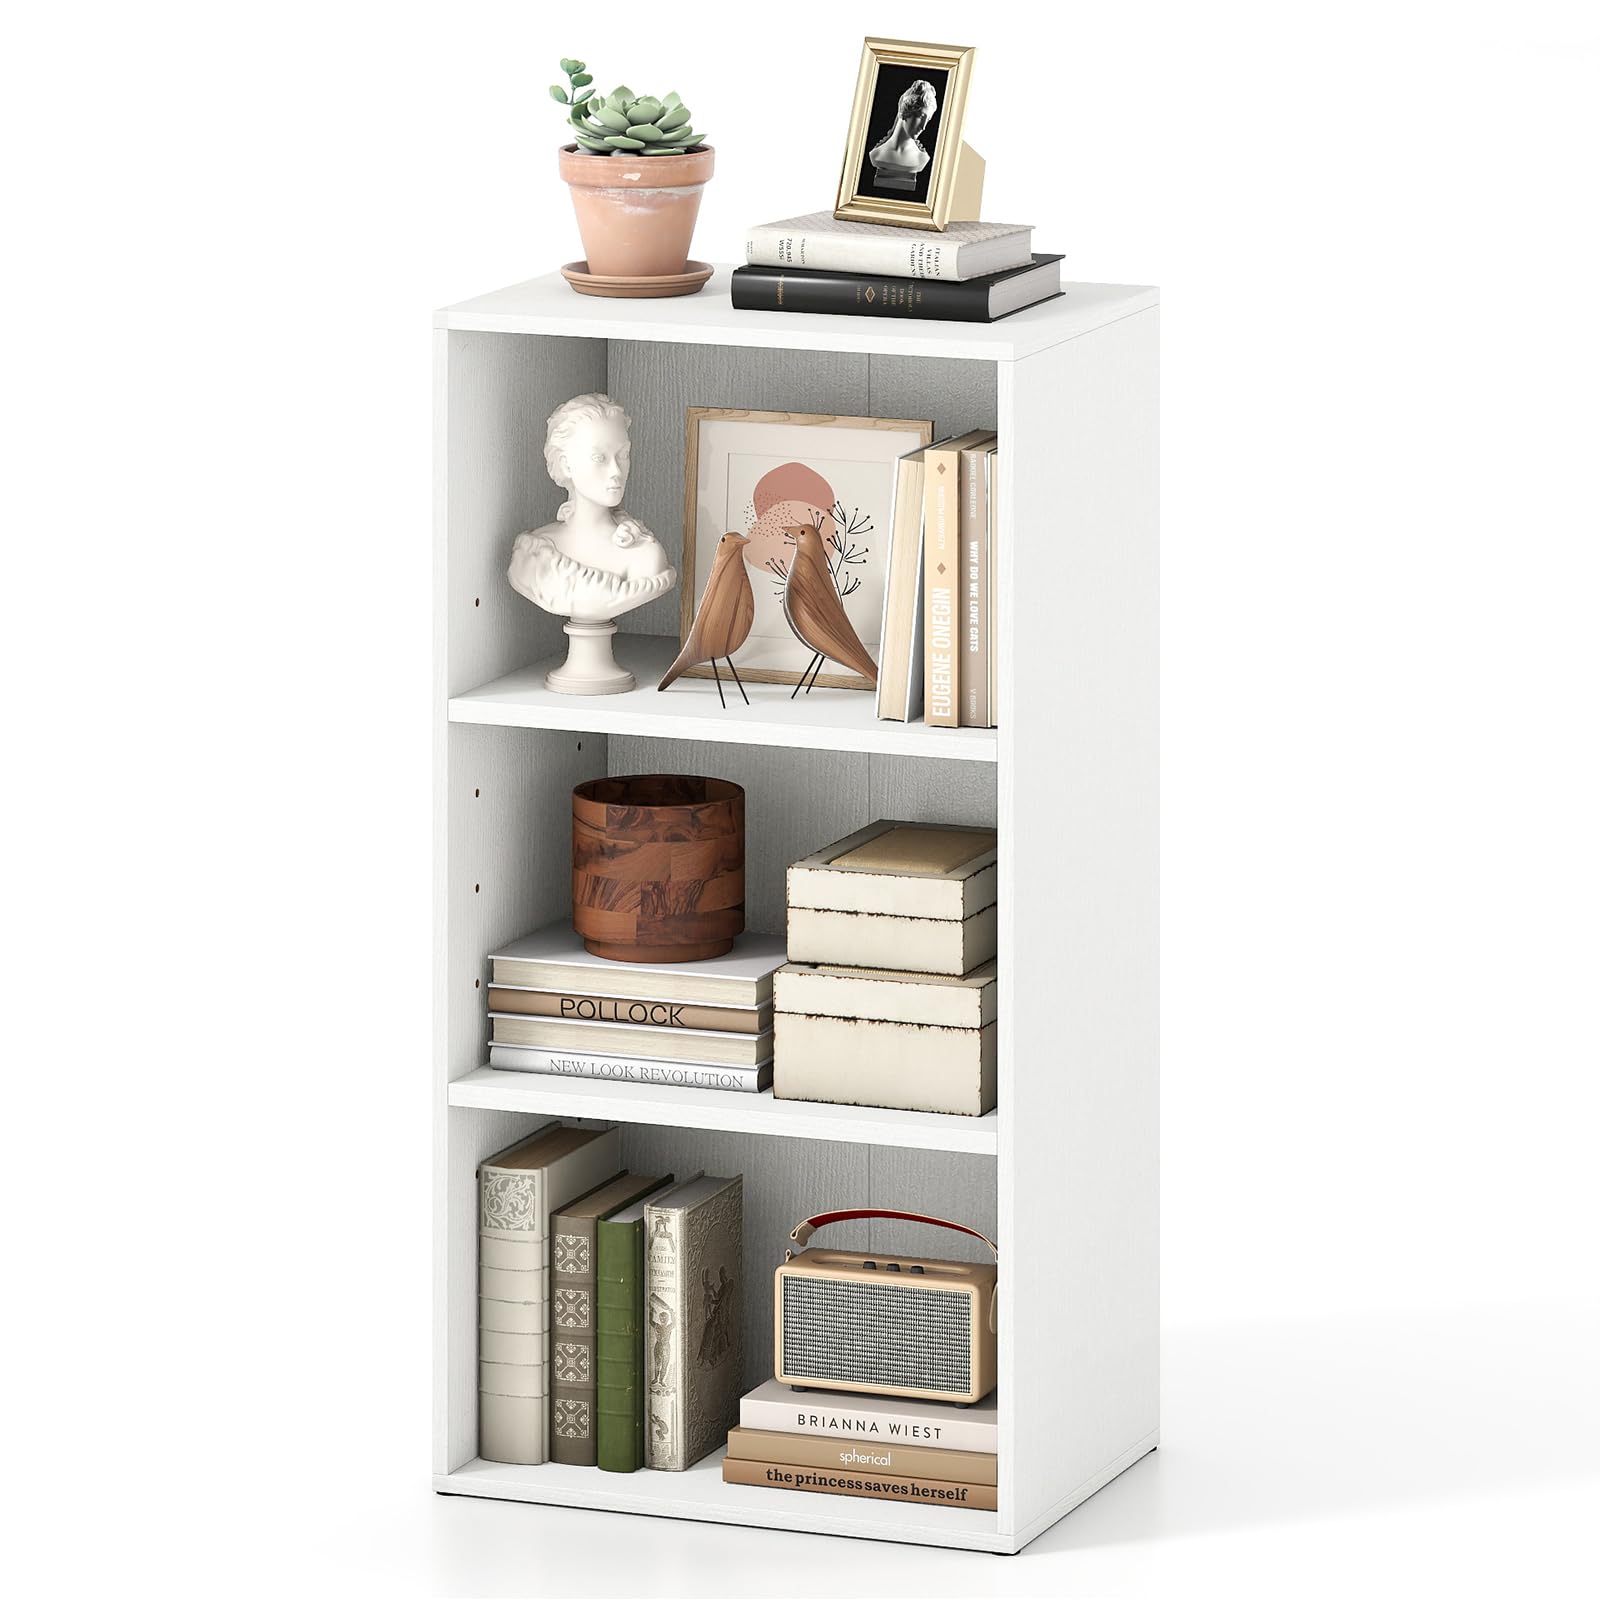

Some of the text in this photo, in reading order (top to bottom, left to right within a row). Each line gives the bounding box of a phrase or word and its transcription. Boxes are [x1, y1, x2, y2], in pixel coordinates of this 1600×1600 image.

[969, 541, 978, 652] WHY DO WE LOVE CATS
[932, 587, 951, 717] EUGENE ONEGIN
[560, 998, 686, 1026] POLLOCK
[550, 1058, 744, 1088] NEW LOOK REVOLUTION
[797, 1414, 942, 1440] BRIANNA WIEST
[839, 1448, 891, 1466] spherical
[766, 1468, 968, 1501] the princess saves herself
